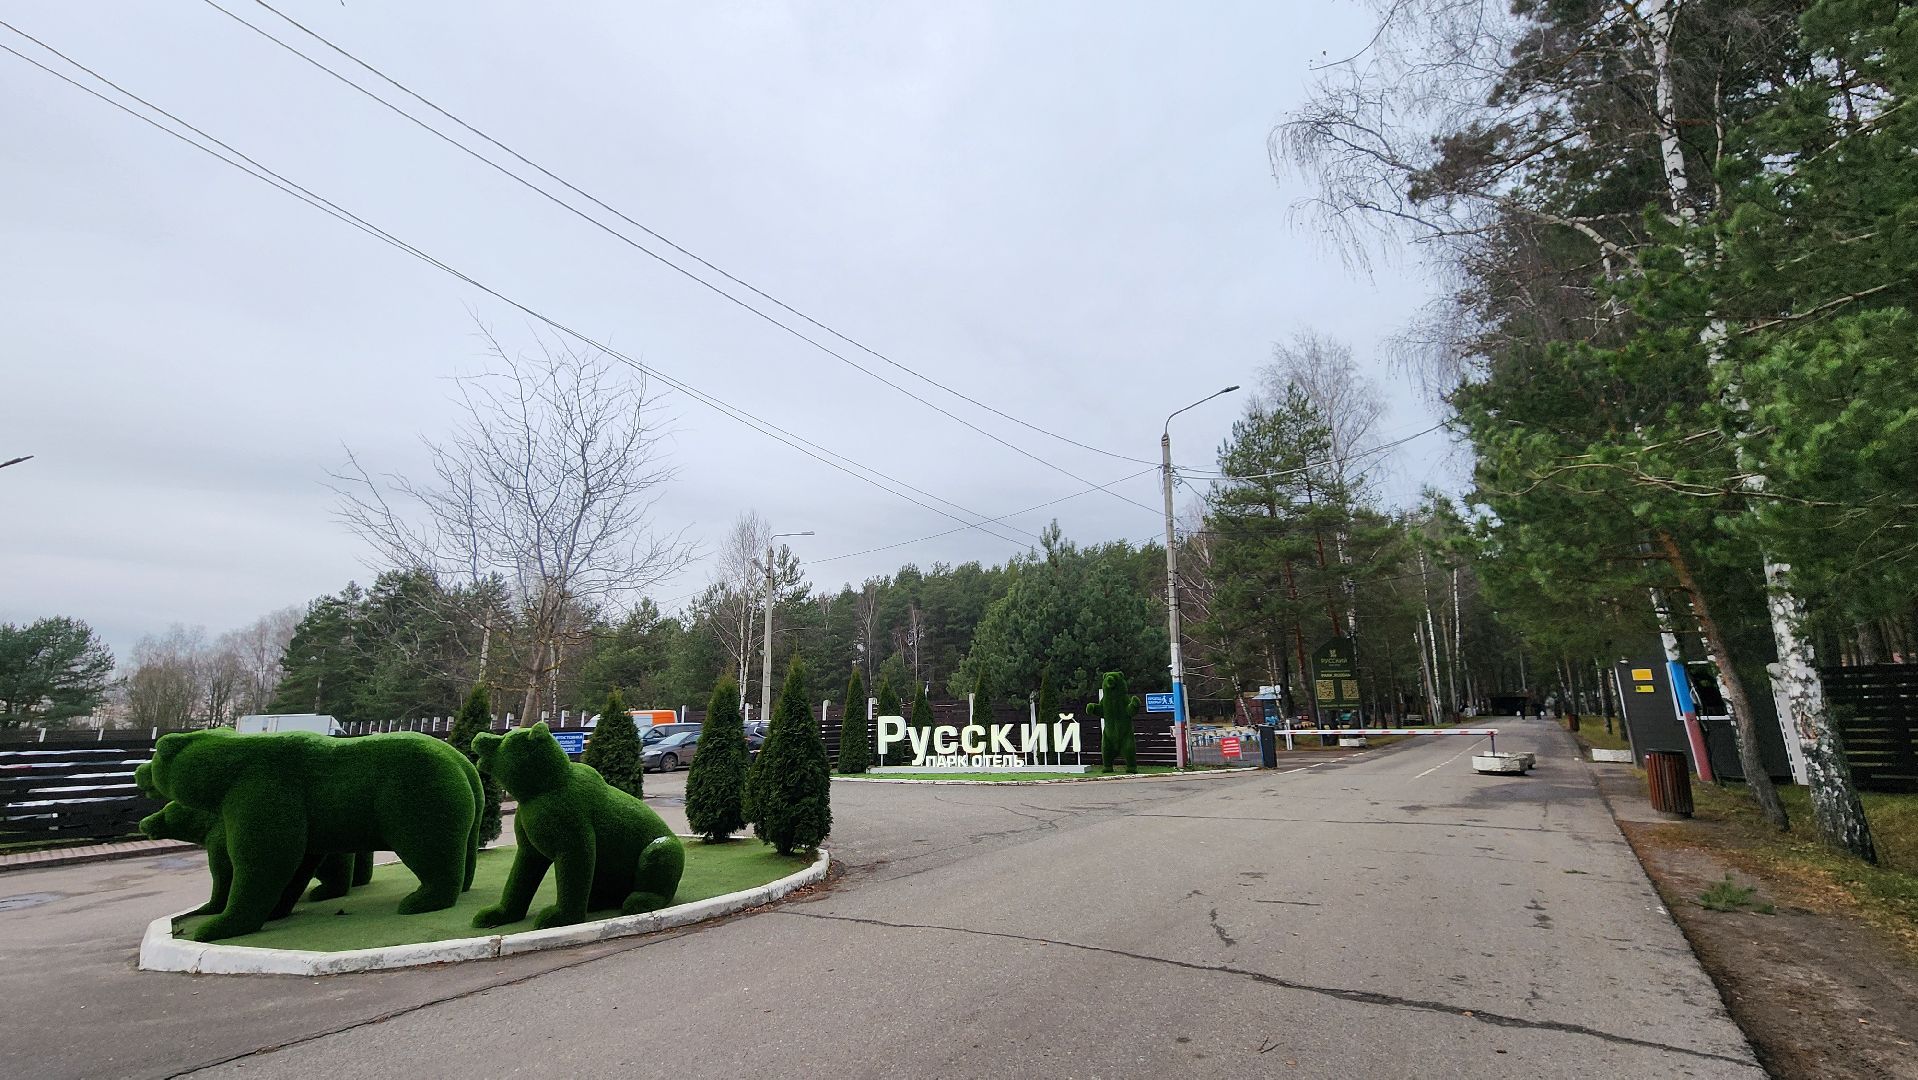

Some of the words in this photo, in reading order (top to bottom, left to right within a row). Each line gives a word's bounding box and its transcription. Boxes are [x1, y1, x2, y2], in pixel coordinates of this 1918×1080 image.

[877, 713, 1081, 765] Русский
[925, 754, 967, 768] ПАРК
[972, 754, 1025, 768] ОТЕЛЬ
